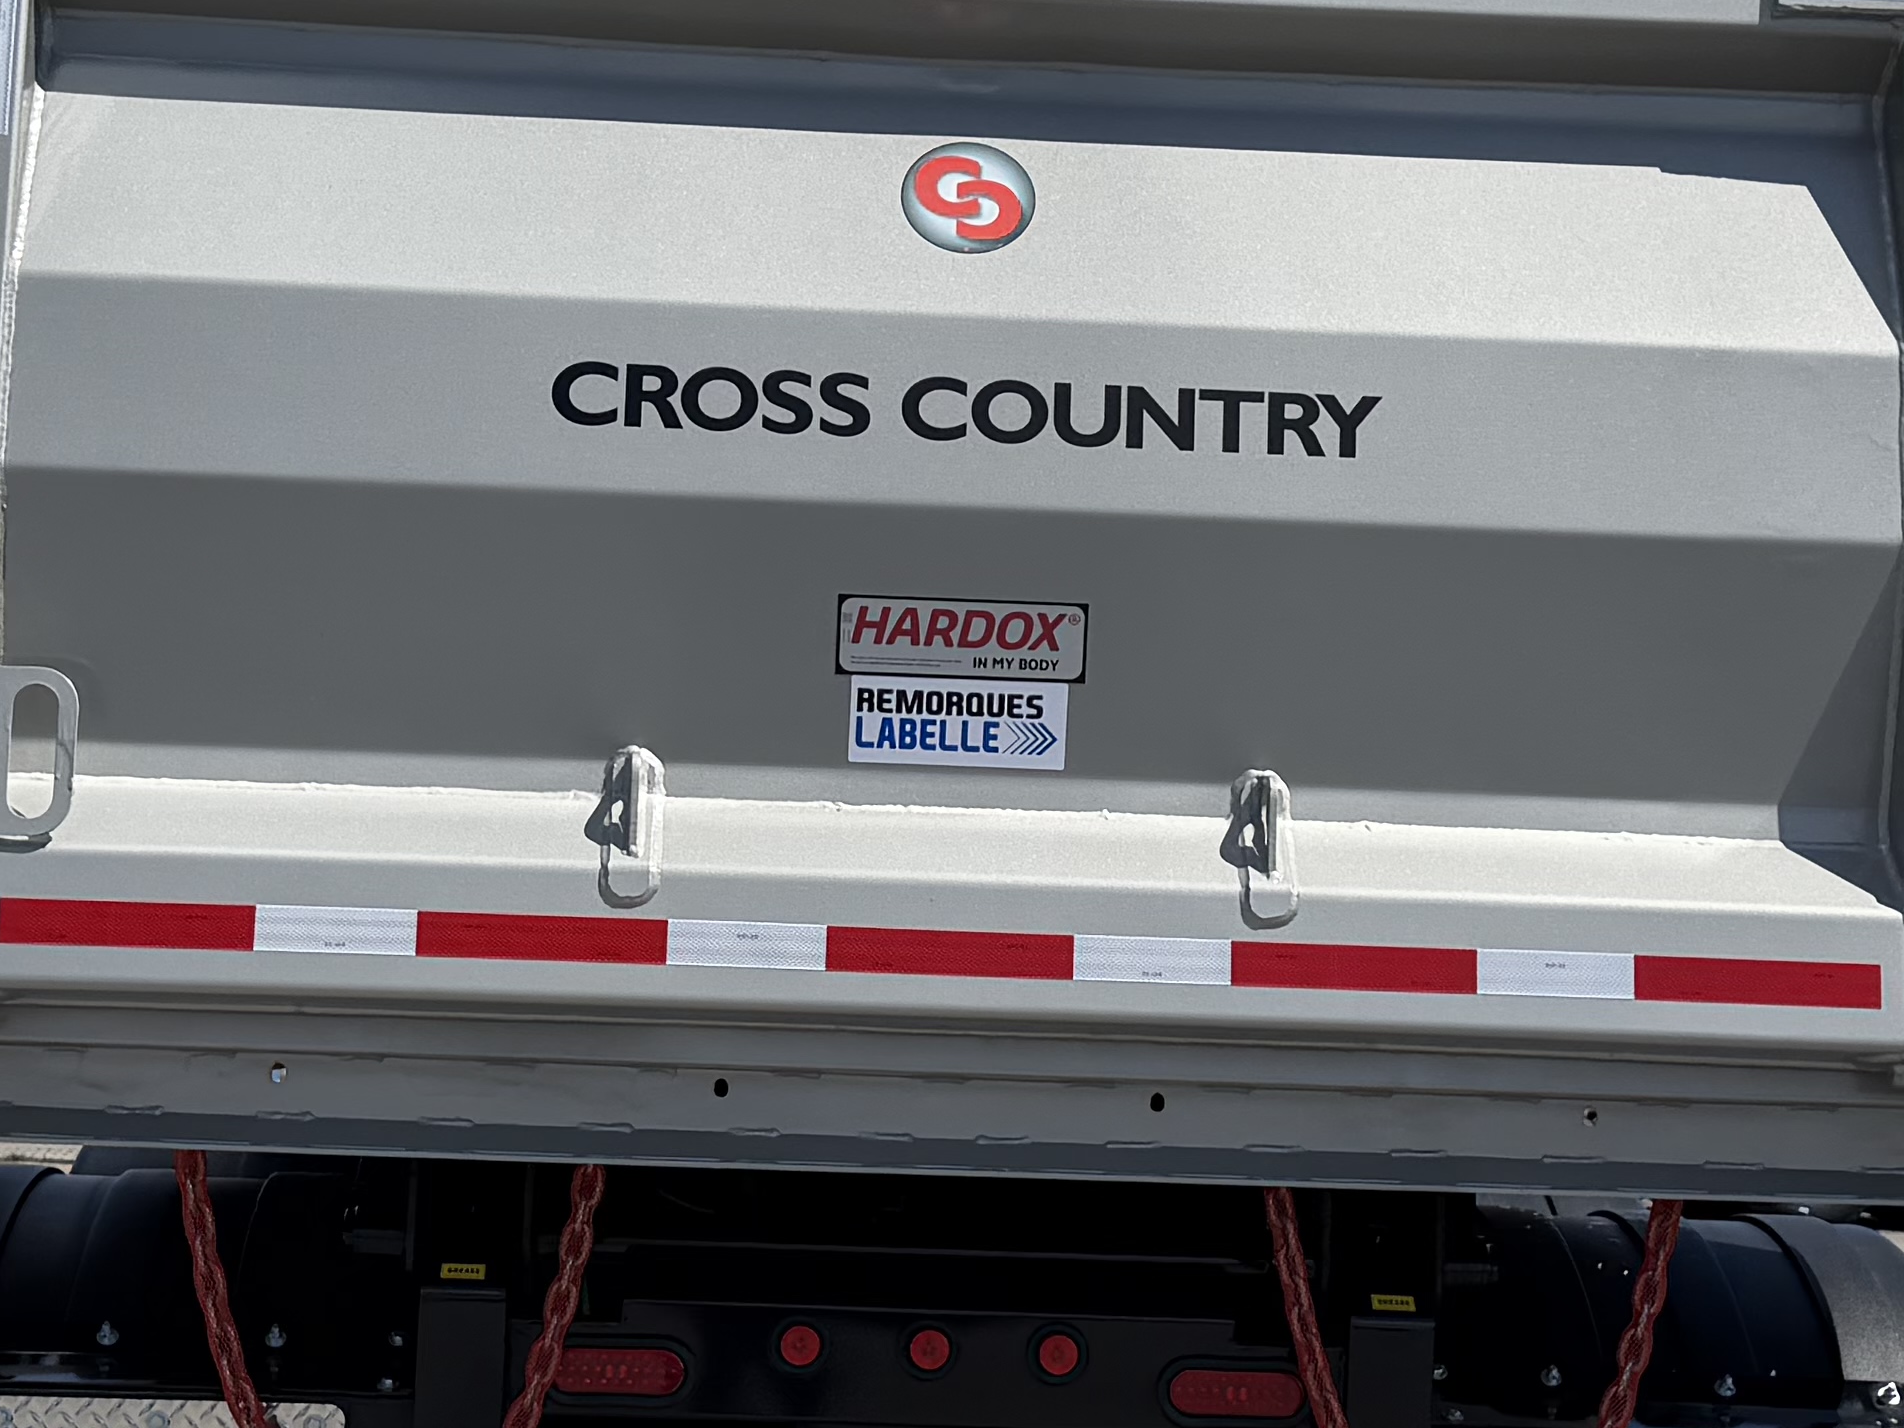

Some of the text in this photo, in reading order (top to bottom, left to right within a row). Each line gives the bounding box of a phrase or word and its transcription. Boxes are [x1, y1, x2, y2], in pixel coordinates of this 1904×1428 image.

[551, 361, 1383, 458] CROSS COUNTRY
[973, 657, 988, 669] IN
[993, 658, 1015, 670] MY
[1019, 658, 1059, 672] BODY
[856, 688, 1043, 719] REMORQUES
[855, 716, 1000, 753] LABELLE
